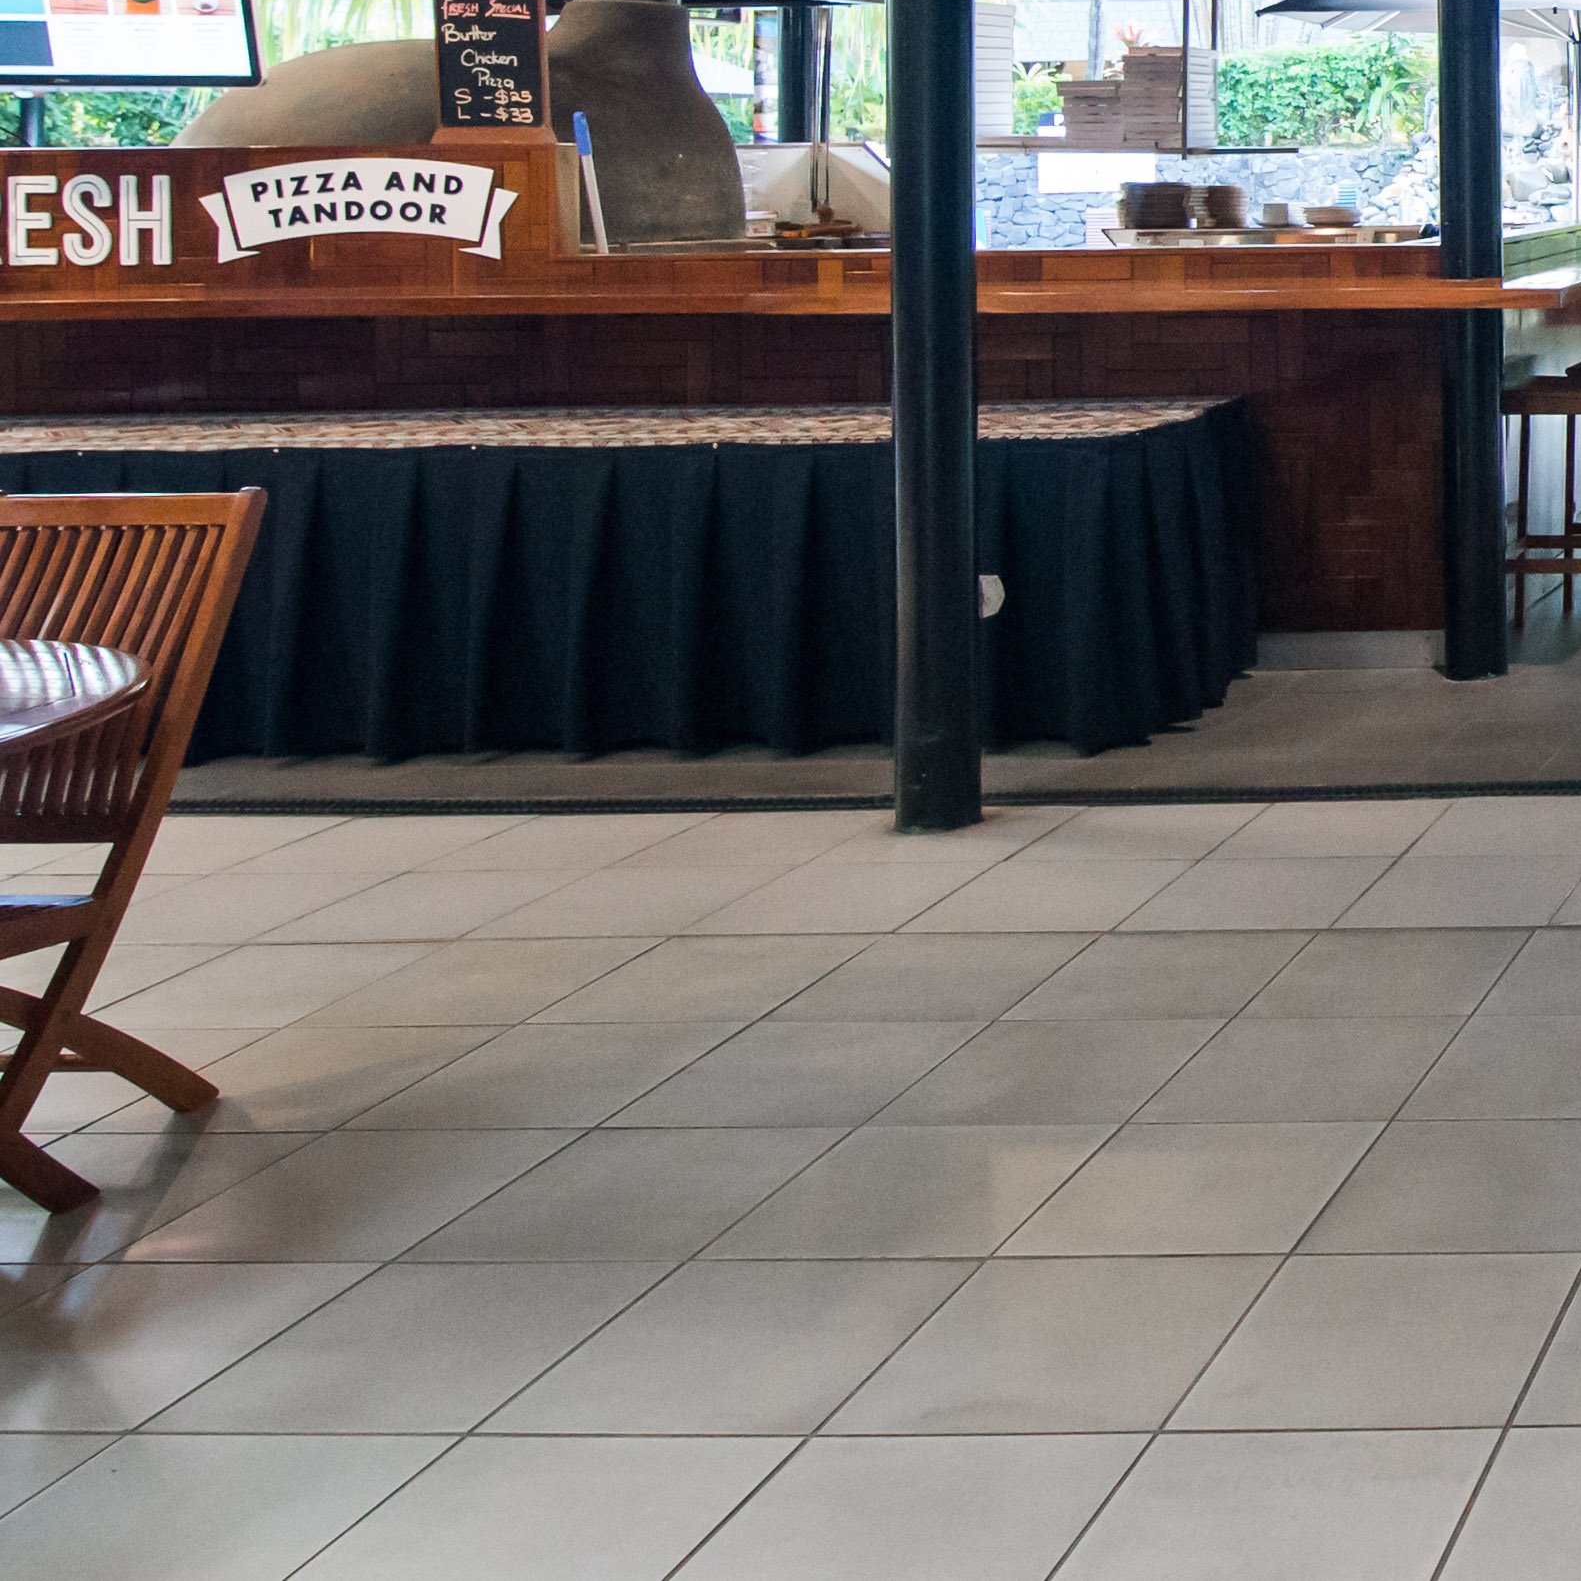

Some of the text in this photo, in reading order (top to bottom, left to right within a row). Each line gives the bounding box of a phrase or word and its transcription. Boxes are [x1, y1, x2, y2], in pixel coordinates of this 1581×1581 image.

[461, 49, 518, 67] Chicken
[250, 171, 464, 202] PIZZA AND
[0, 174, 171, 266] ESH
[268, 199, 447, 228] TANDOOR
